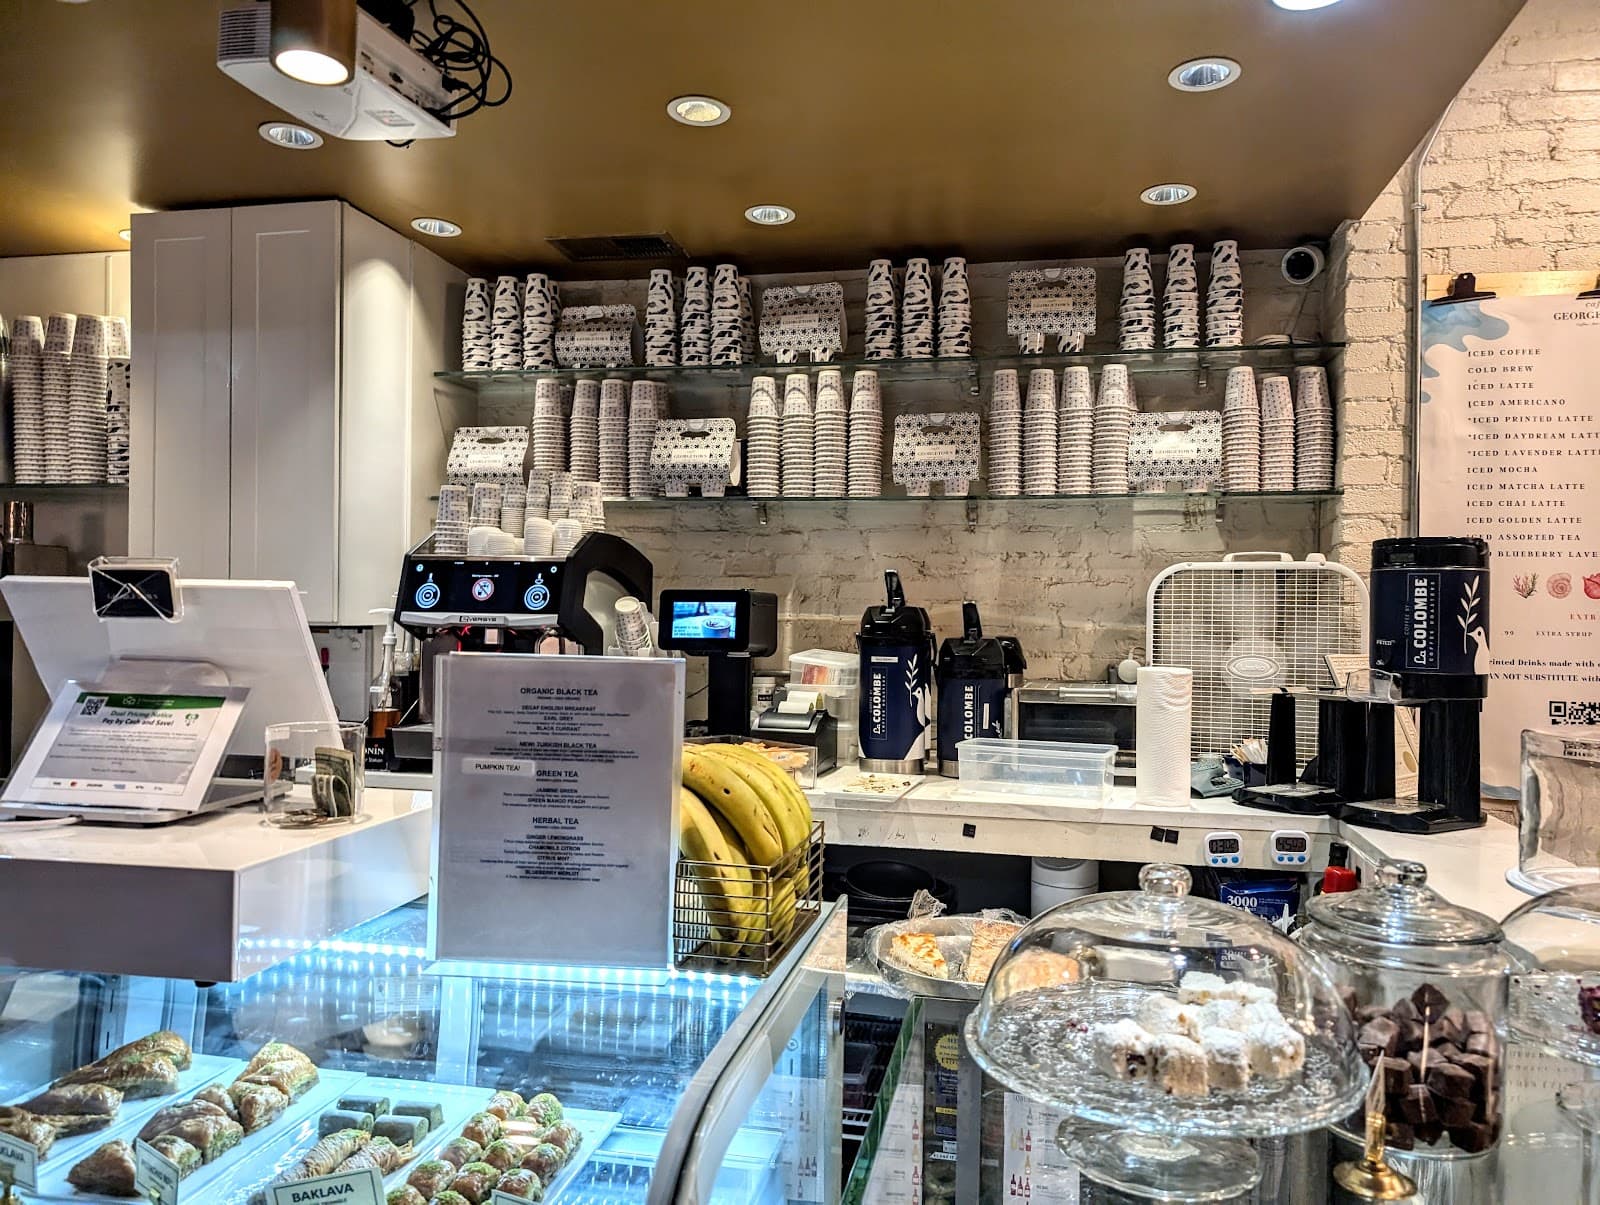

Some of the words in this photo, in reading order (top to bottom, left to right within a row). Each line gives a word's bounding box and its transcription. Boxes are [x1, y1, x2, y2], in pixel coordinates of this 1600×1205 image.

[1468, 350, 1494, 358] ICED
[1414, 578, 1428, 648] COLOMBE
[1524, 673, 1578, 681] SUBSTITUTE
[873, 673, 882, 722] COLOMBE
[964, 686, 974, 740] COLOMBE
[1226, 895, 1258, 908] 3000
[292, 1183, 354, 1202] BAKLAVA
